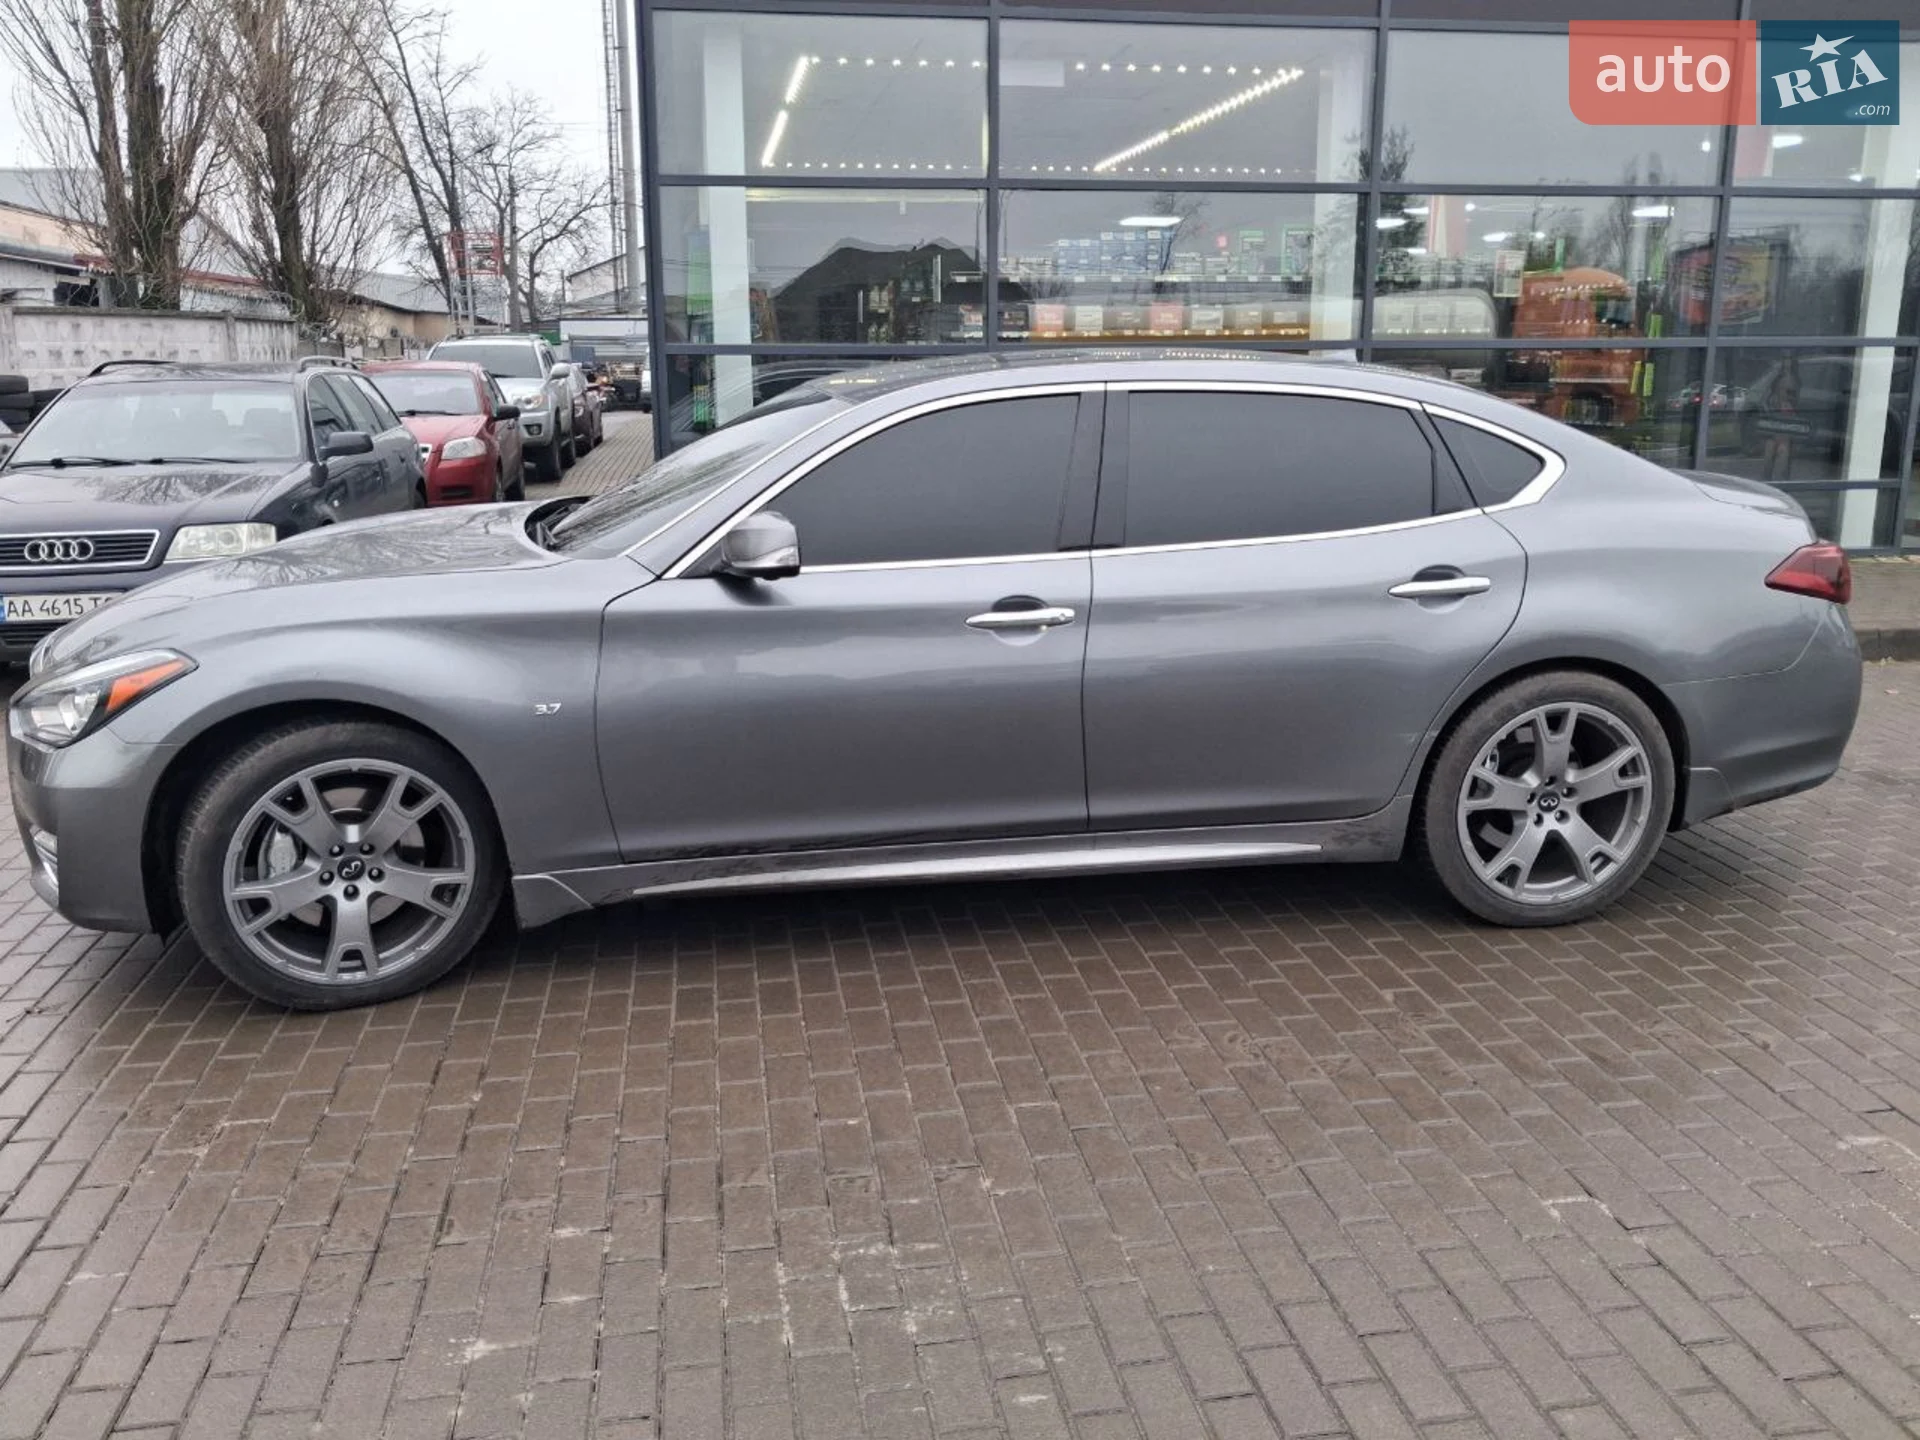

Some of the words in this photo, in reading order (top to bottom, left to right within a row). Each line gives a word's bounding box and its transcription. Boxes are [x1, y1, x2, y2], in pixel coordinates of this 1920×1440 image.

[7, 600, 34, 617] AA
[40, 598, 84, 616] 4615
[88, 597, 113, 609] T
[535, 702, 562, 715] 3.7
